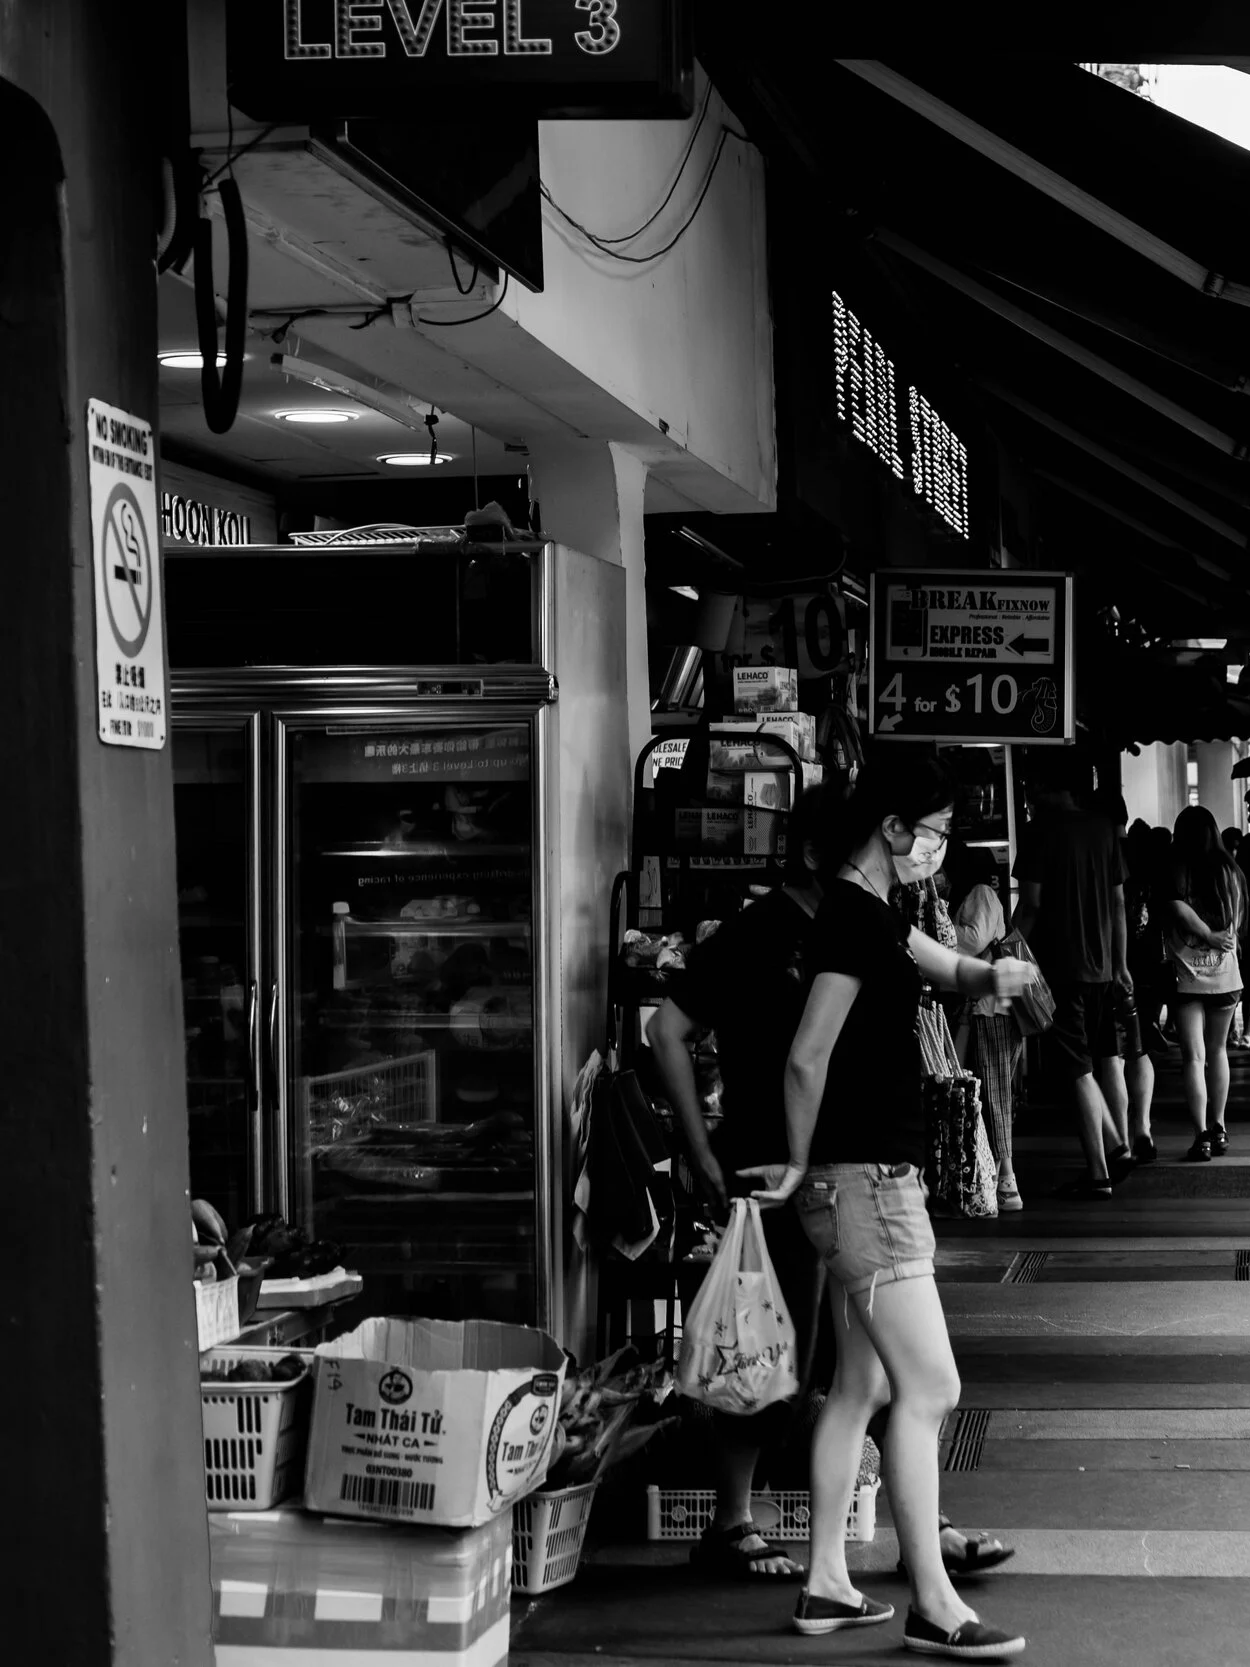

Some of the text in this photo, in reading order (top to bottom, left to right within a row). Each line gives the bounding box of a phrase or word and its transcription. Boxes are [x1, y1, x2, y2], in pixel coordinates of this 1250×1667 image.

[284, 0, 620, 59] LEVEL 3
[95, 412, 148, 456] NO SMOKING
[911, 589, 1049, 611] BREAK FIXNOW
[929, 625, 1005, 645] EXPRESS
[929, 647, 997, 659] MOBILE REPAIR
[737, 671, 768, 680] LEHACO
[878, 672, 1018, 714] 4 for $10
[653, 743, 688, 753] OLESALE
[707, 812, 738, 820] LEHACO
[345, 1403, 376, 1429] Tam
[380, 1404, 416, 1433] Thái
[402, 1436, 420, 1449] CA
[502, 1441, 524, 1461] Tam
